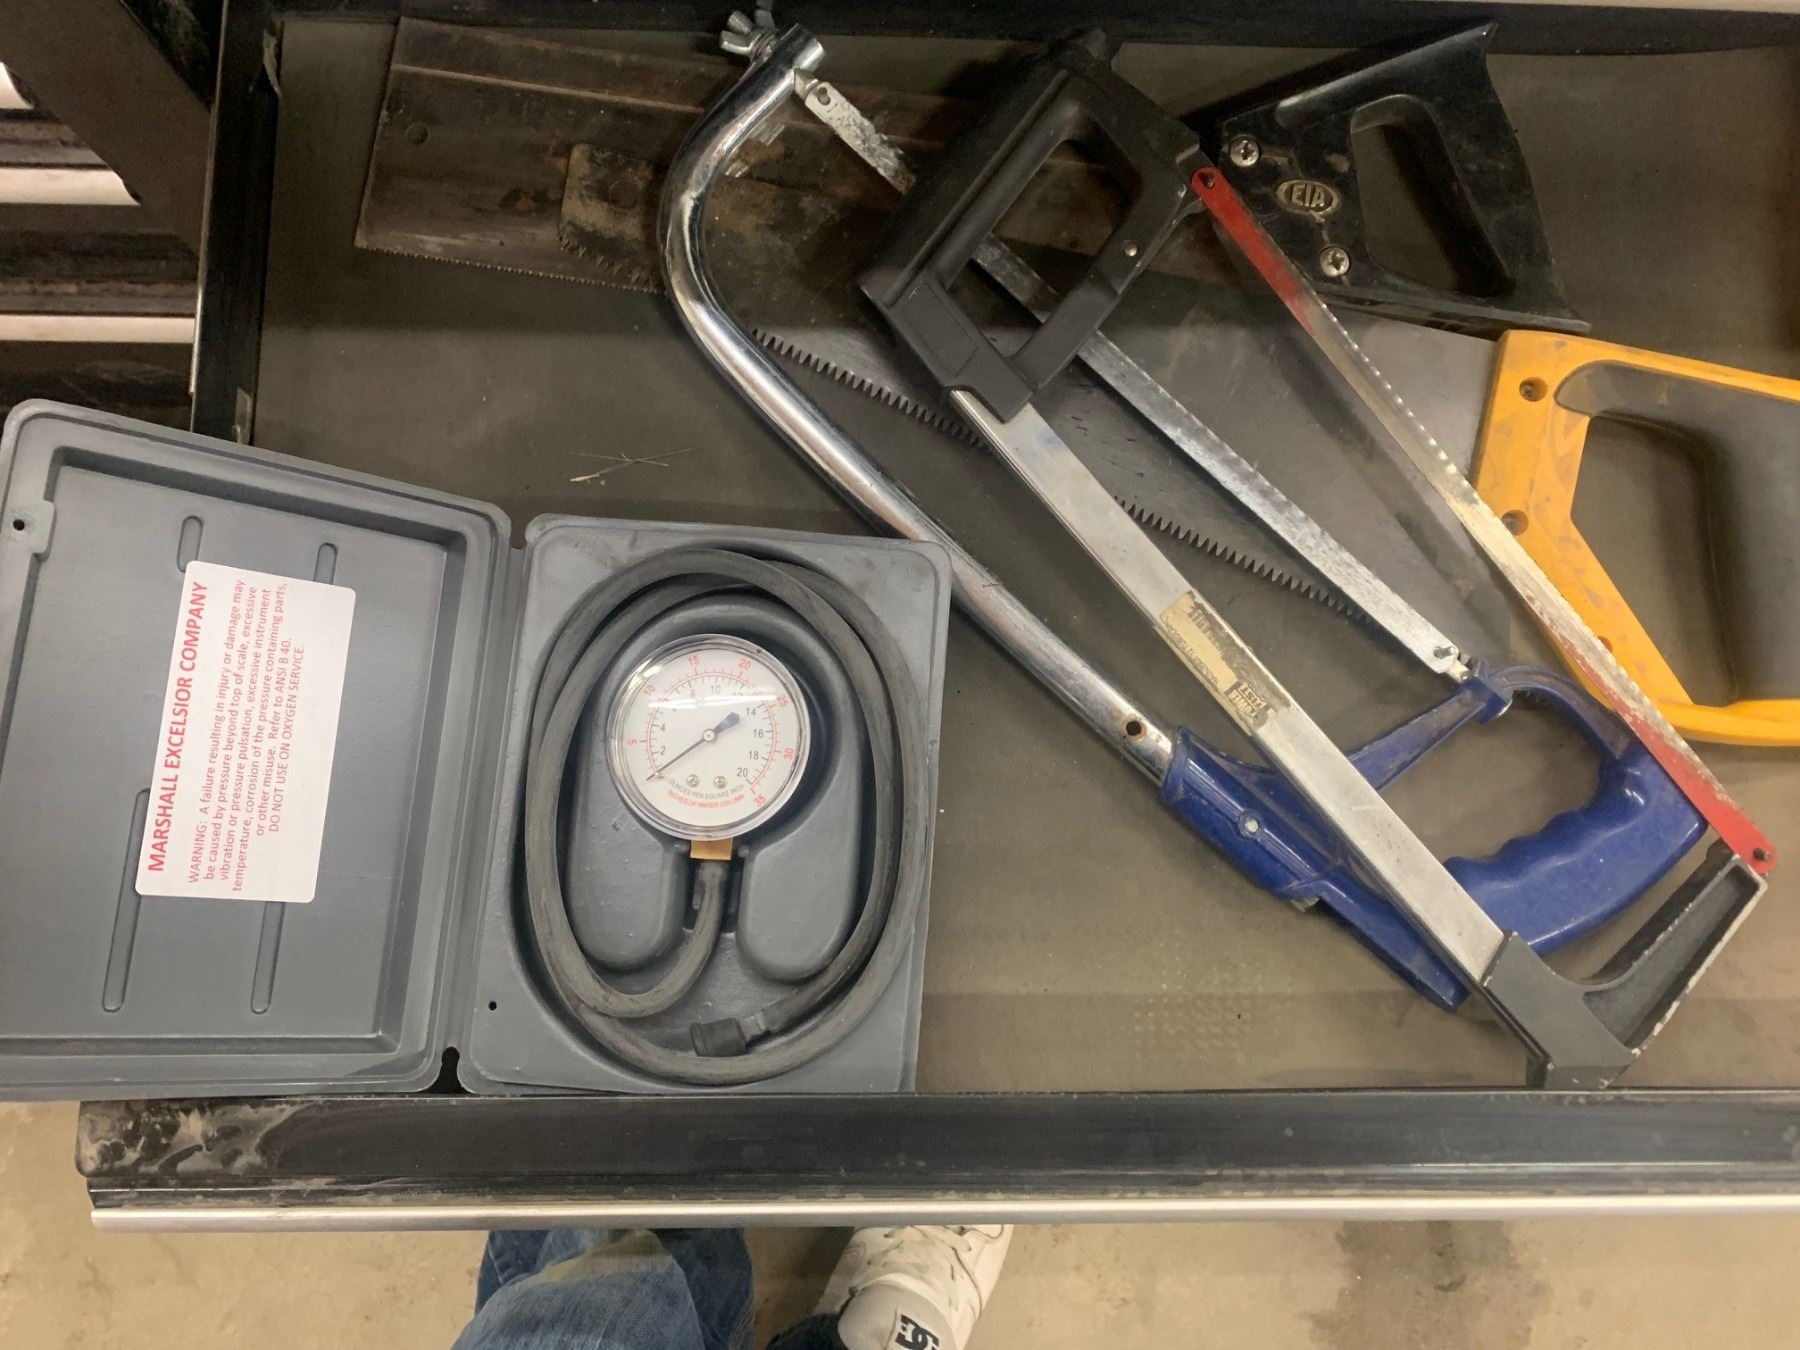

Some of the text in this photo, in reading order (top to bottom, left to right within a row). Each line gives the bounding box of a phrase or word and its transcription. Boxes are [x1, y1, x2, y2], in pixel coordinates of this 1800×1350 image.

[232, 580, 246, 603] may
[240, 587, 257, 637] excessive
[252, 590, 271, 648] instrument
[223, 606, 242, 649] damage
[264, 616, 283, 672] containing
[223, 653, 233, 664] or
[688, 655, 700, 666] 15
[739, 659, 751, 671] 20
[216, 668, 233, 699] injury
[232, 673, 244, 684] of
[244, 652, 262, 702] excessive
[274, 668, 287, 692] ANSI
[229, 688, 244, 707] top
[258, 676, 275, 721] pressure
[644, 685, 656, 696] 10
[710, 685, 721, 695] 10
[214, 702, 225, 711] in
[273, 696, 283, 706] to
[777, 695, 789, 707] 25
[282, 695, 298, 739] OXYGEN
[746, 704, 757, 716] 14
[148, 582, 208, 872] MARSHALL EXCELSIOR COMPANY
[223, 710, 241, 751] beyond
[267, 710, 281, 739] Refer
[660, 723, 666, 732] 4
[206, 715, 226, 764] resulting
[253, 725, 265, 743] the
[753, 729, 764, 738] 16
[251, 746, 262, 757] of
[279, 743, 291, 759] ON
[660, 746, 666, 755] 2
[749, 751, 759, 760] 18
[783, 748, 794, 760] 30
[217, 754, 235, 802] pressure
[276, 764, 288, 783] USE
[737, 767, 748, 777] 20
[200, 767, 216, 803] failure
[230, 763, 248, 811] pressure
[243, 761, 260, 813] corrosion
[256, 790, 270, 820] other
[272, 787, 285, 811] NOT
[754, 794, 766, 807] 35
[199, 806, 210, 814] A
[213, 806, 227, 819] by
[228, 815, 238, 826] or
[269, 815, 281, 831] DO
[256, 824, 266, 835] or
[207, 823, 223, 862] caused
[218, 831, 236, 881] vibration
[204, 866, 216, 879] be
